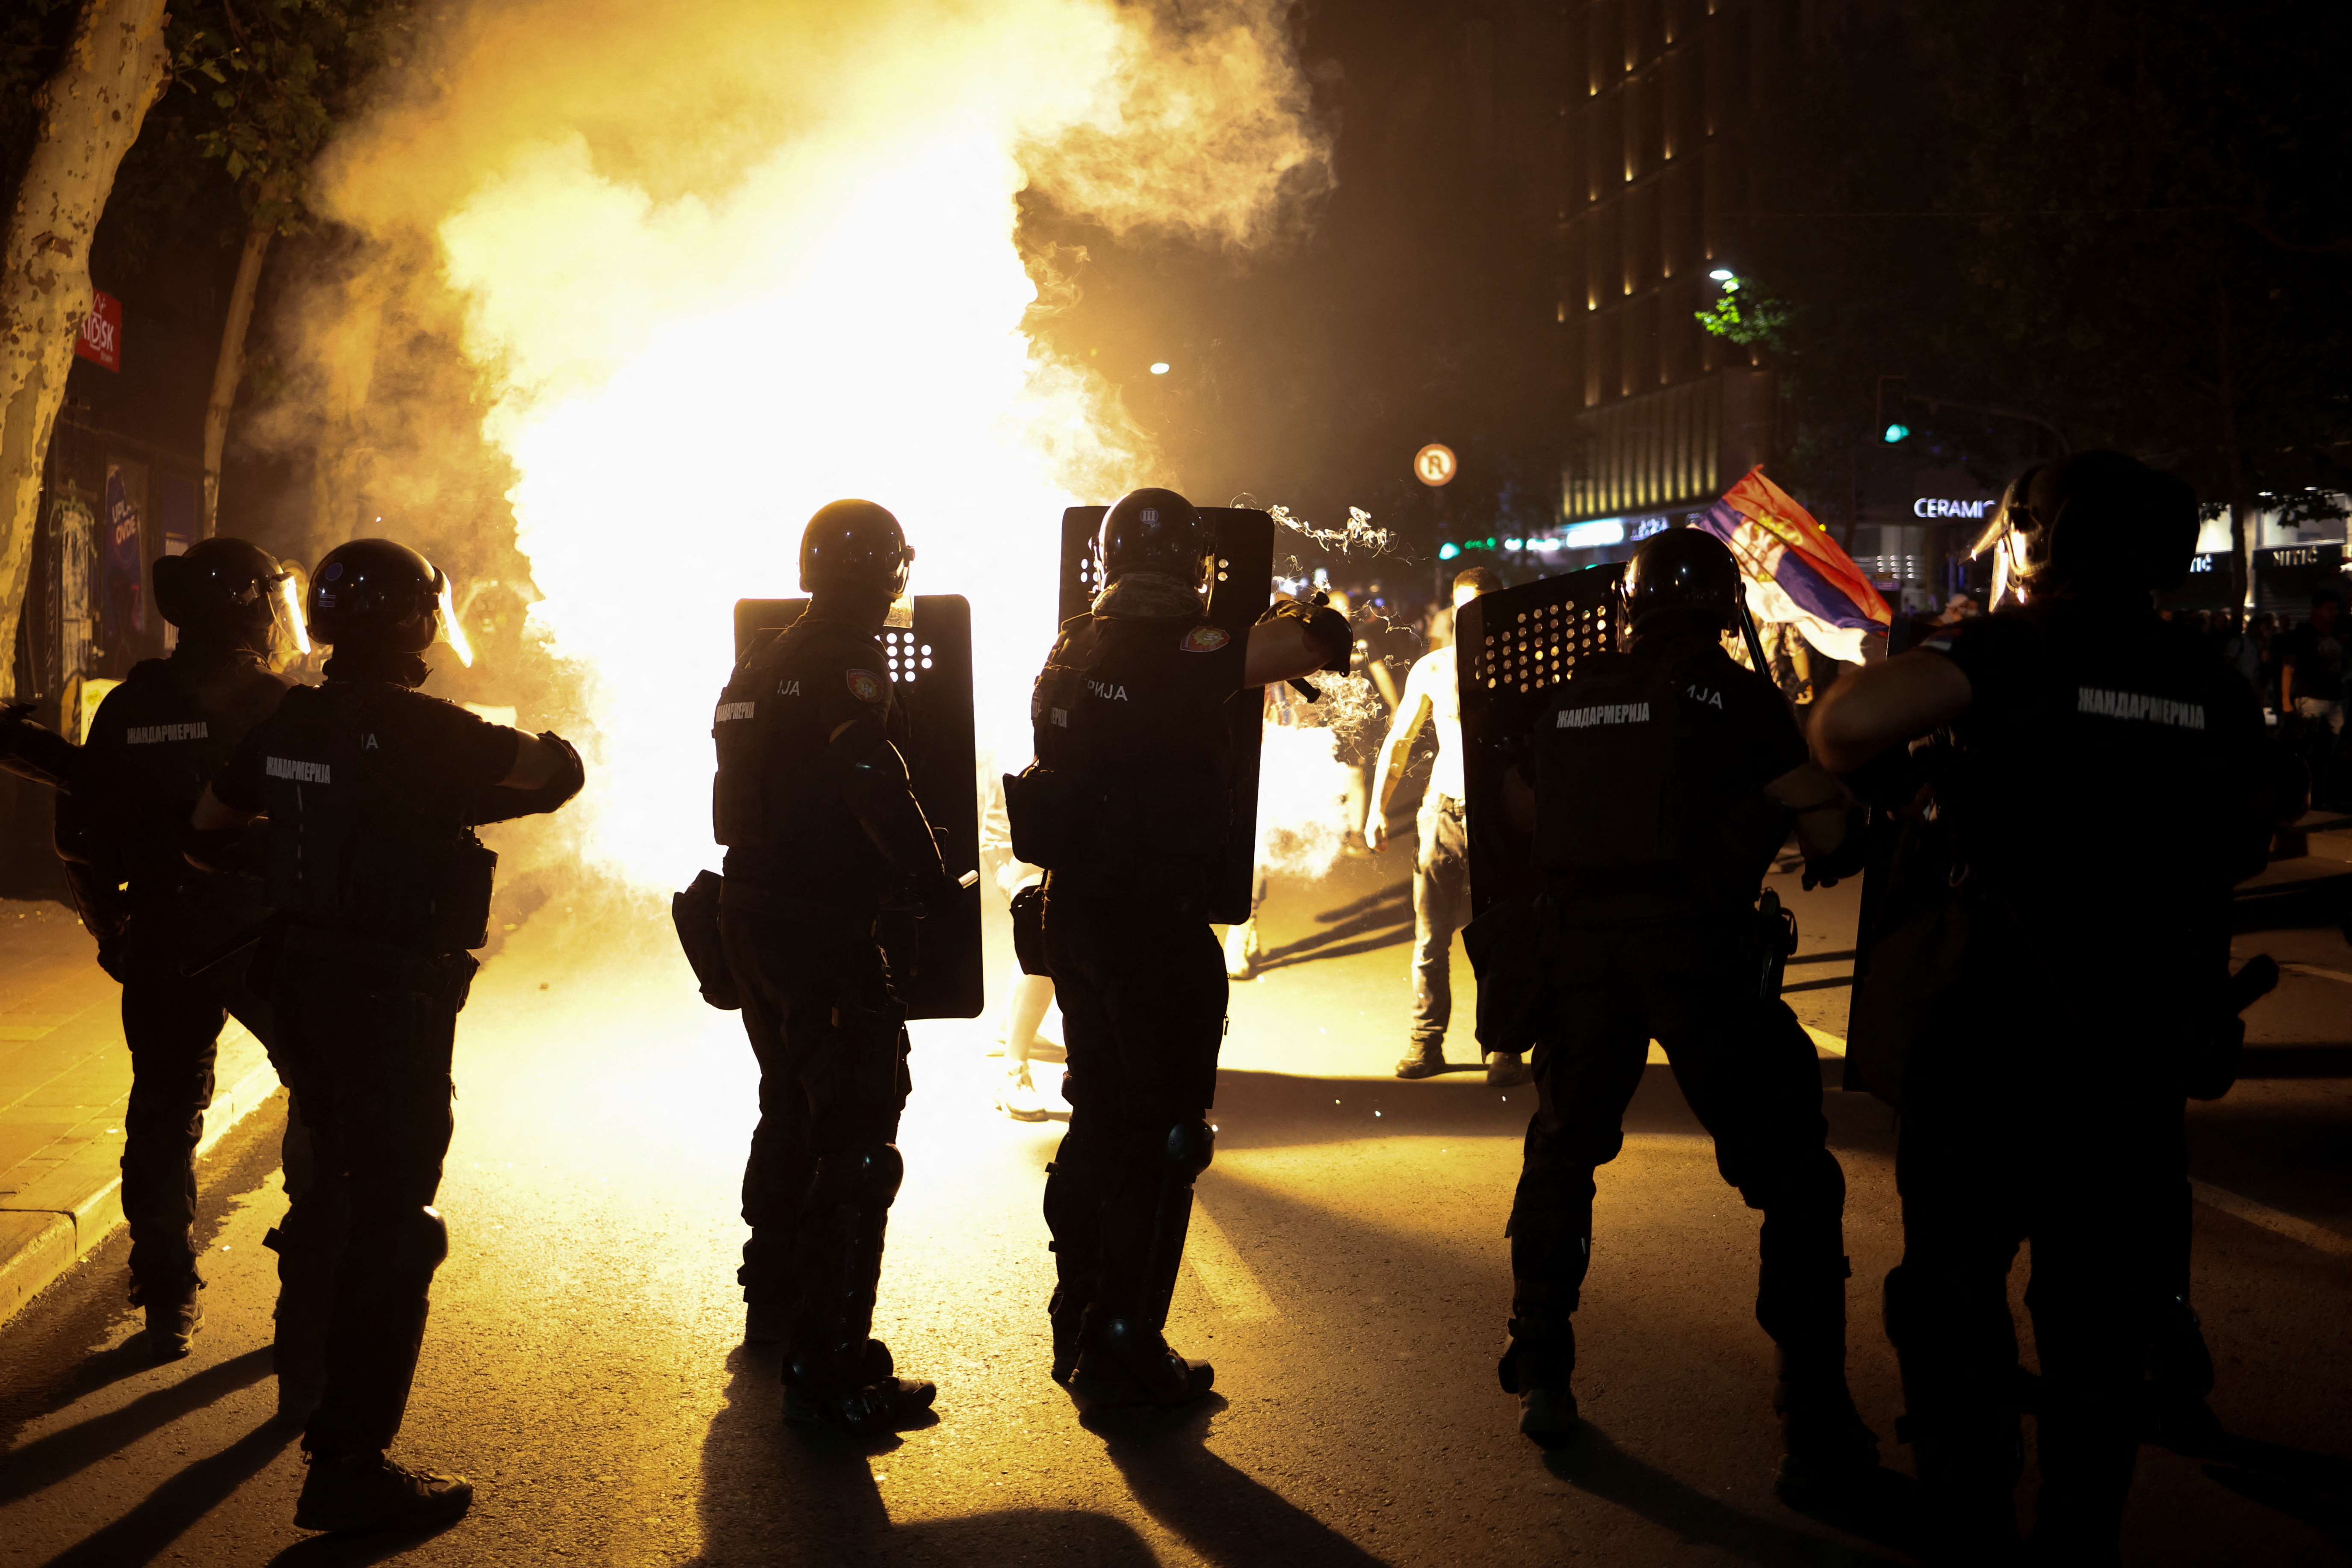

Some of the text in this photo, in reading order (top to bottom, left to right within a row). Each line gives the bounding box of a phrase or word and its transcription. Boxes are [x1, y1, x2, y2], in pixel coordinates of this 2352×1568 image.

[1556, 702, 1650, 728] ЖАНДАРМЕРИЈА
[2077, 685, 2205, 731] ЖАНДАРМЕРИЈА
[127, 721, 208, 744] ЖАНДАРМЕРИЈА
[266, 756, 331, 784] ЖАНДАРМЕРИЈА
